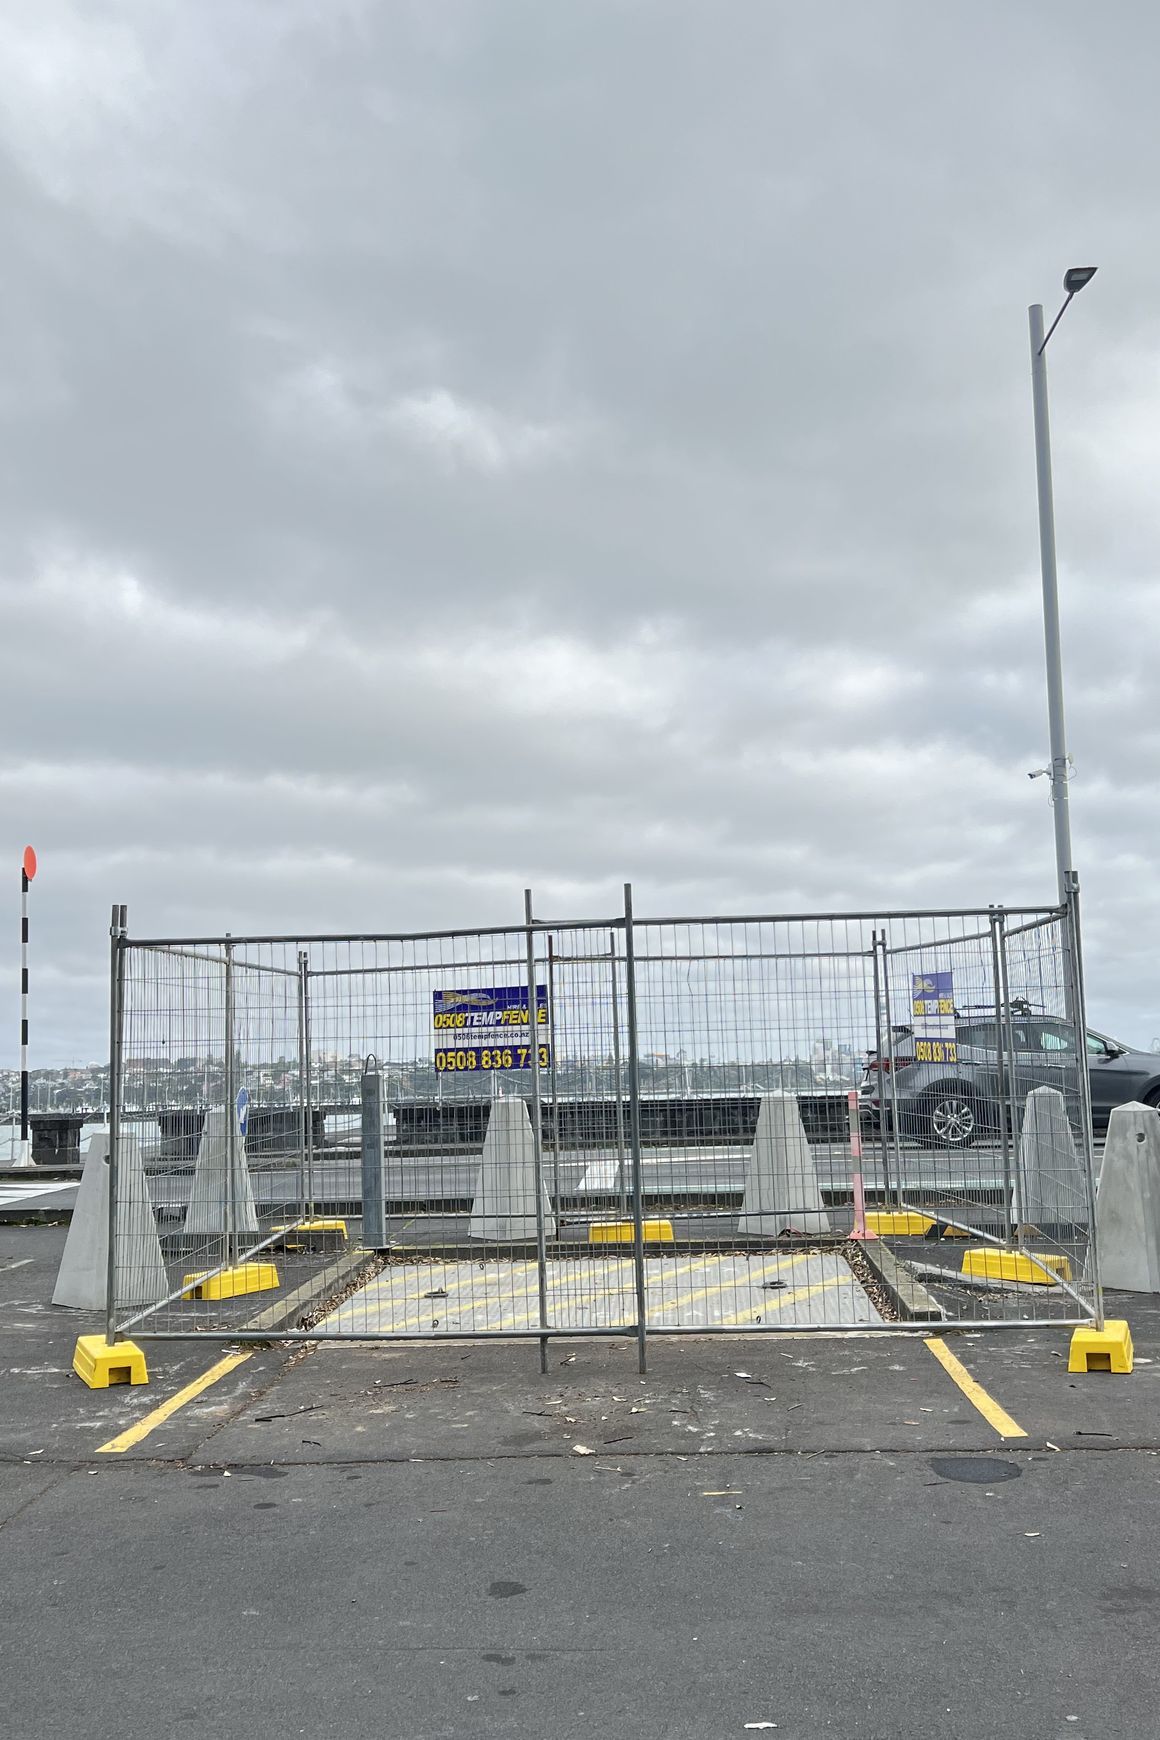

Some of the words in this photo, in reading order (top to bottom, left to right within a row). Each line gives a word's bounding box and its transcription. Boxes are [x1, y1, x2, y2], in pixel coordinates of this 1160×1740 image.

[434, 1009, 547, 1028] 0508TEMPFENE
[436, 1051, 477, 1070] 0508
[481, 1049, 512, 1069] 836
